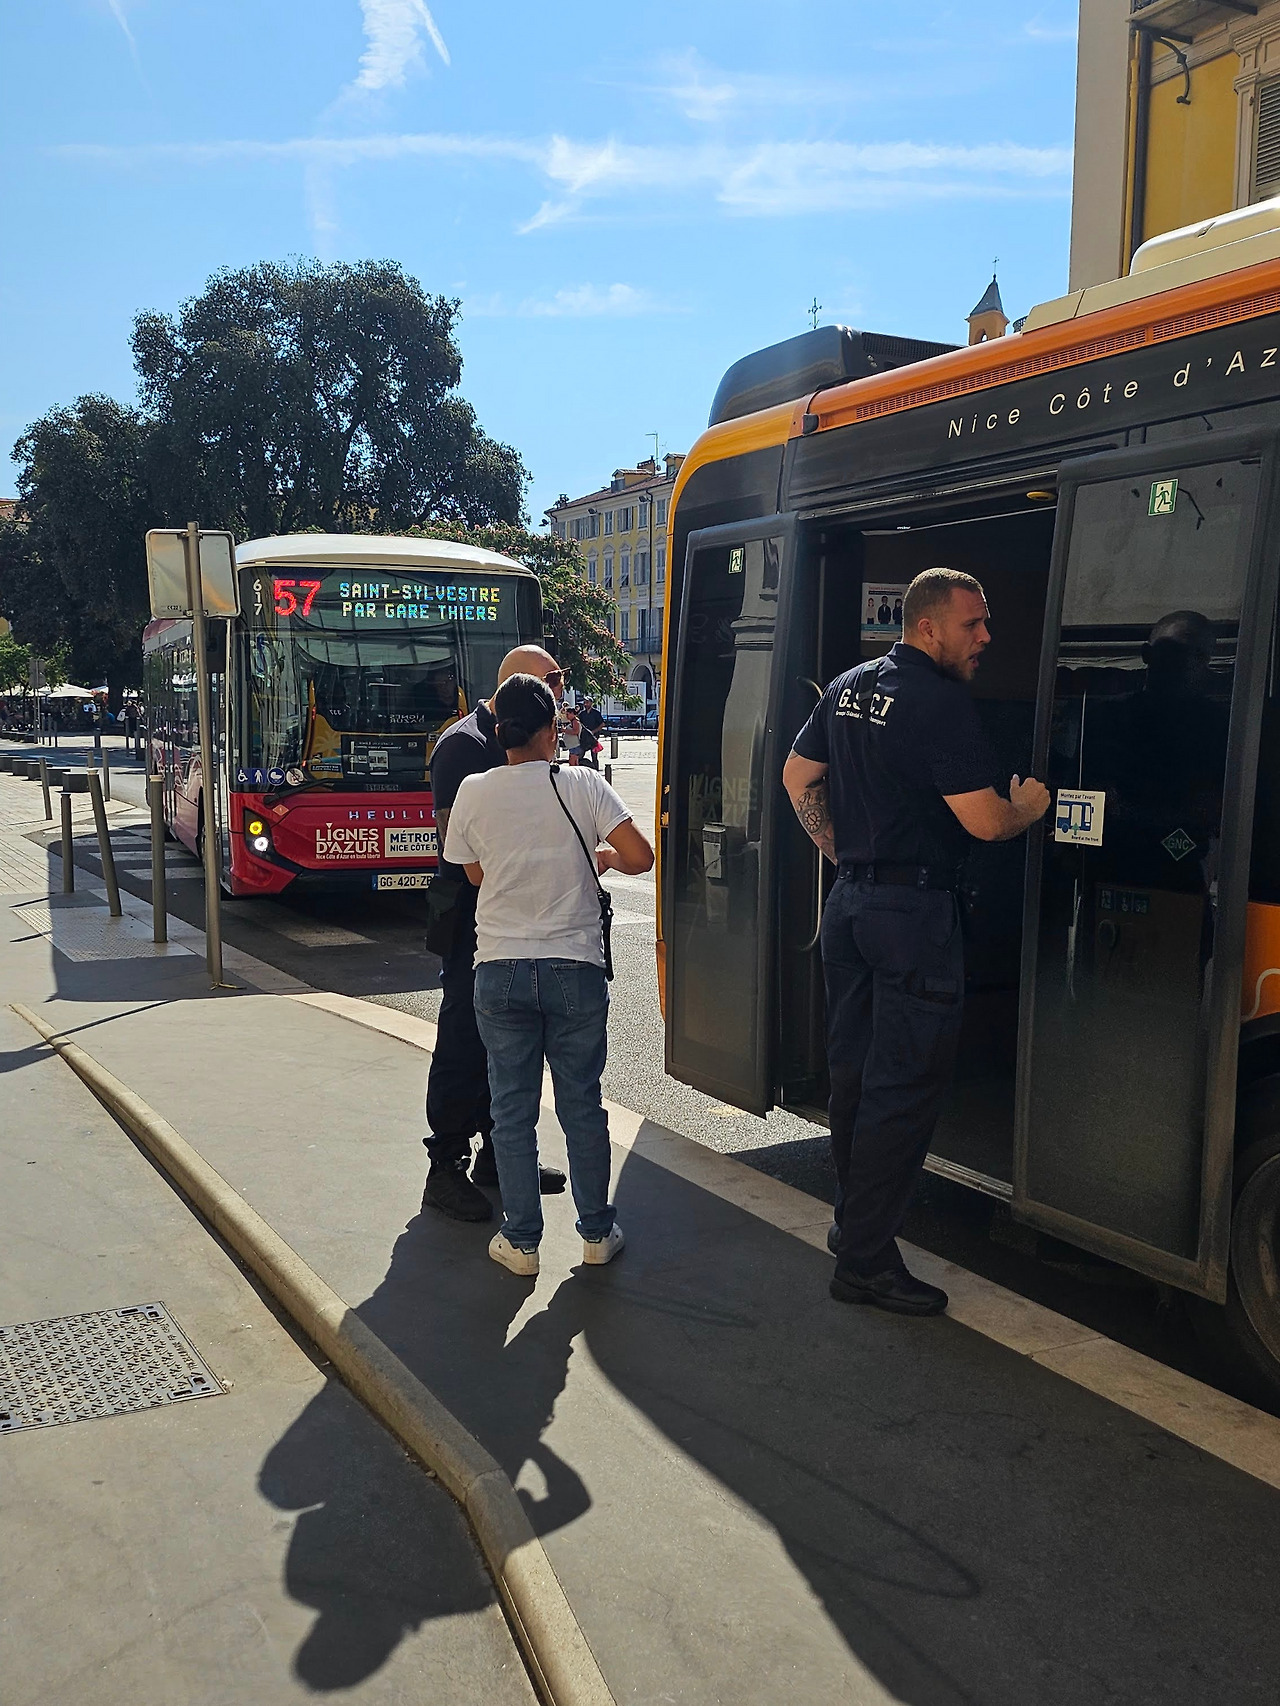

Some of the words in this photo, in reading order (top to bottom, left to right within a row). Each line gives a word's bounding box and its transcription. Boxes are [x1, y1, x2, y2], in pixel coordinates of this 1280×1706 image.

[948, 408, 1021, 439] Nice
[1049, 380, 1140, 415] Côte
[273, 579, 321, 617] 57
[339, 582, 500, 602] SAINT-SYLVESTRE
[342, 602, 377, 617] PAR
[385, 603, 430, 618] GARE
[437, 604, 498, 621] THIERS
[316, 841, 380, 854] D'AZUR
[410, 843, 430, 851] CÔTE
[1168, 837, 1190, 851] GNC
